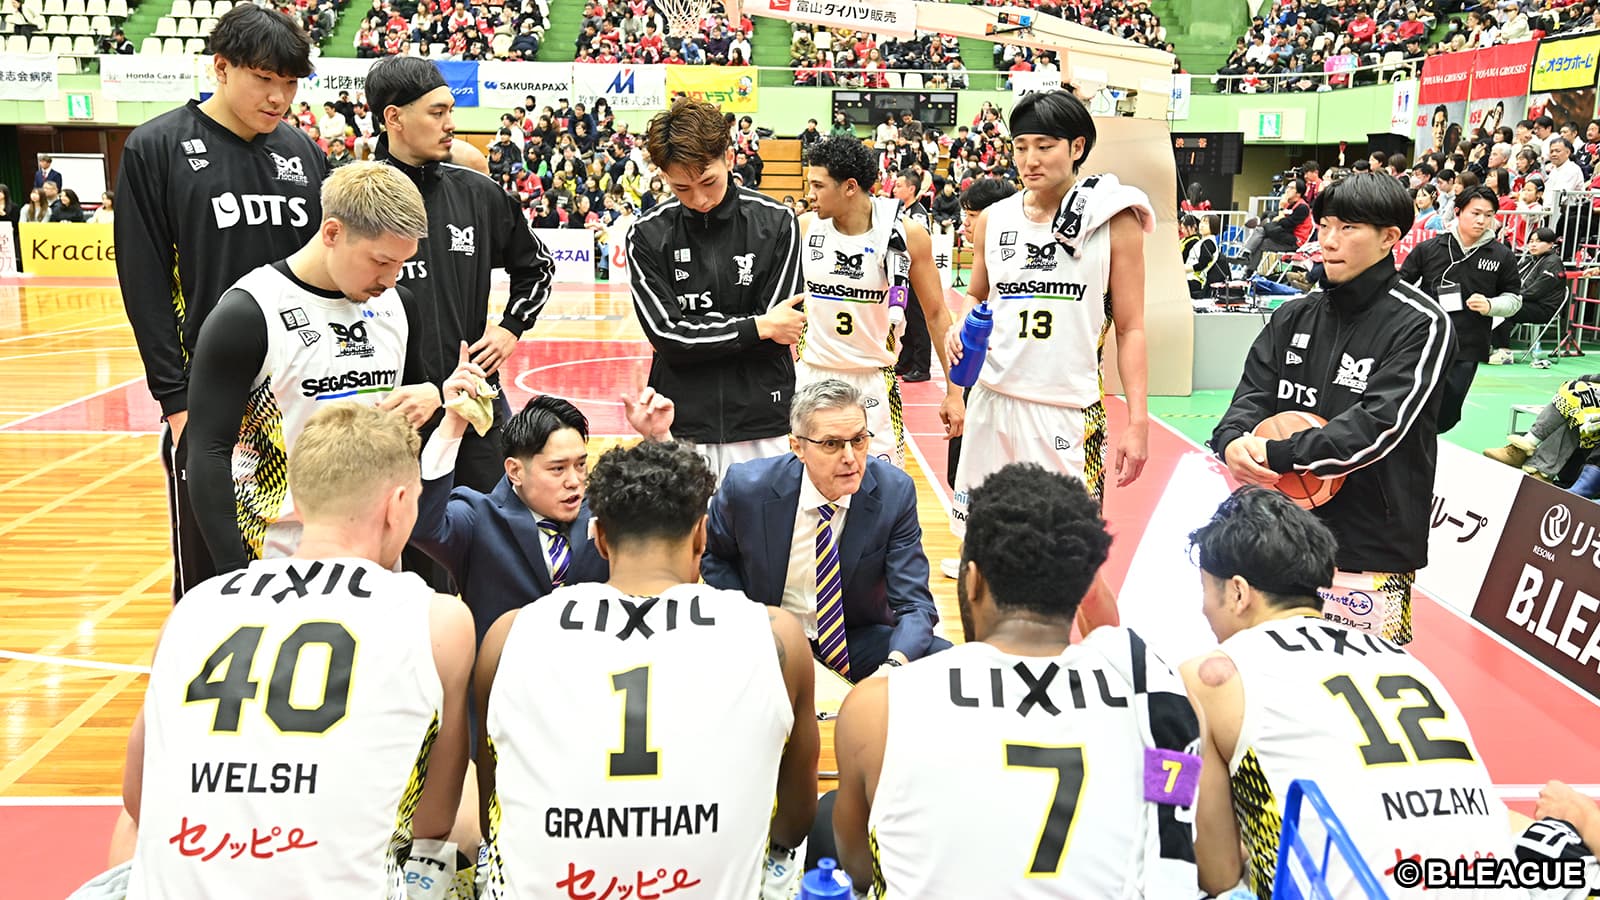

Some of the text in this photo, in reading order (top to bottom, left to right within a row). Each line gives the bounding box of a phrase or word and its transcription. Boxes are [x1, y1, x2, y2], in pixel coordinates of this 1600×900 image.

[500, 82, 568, 91] SAKURAPAXX
[241, 194, 309, 227] DTS
[32, 239, 116, 261] Kracie
[806, 281, 888, 304] SEGASammy
[897, 289, 906, 303] 3
[996, 280, 1087, 301] SEGASammy
[835, 311, 853, 336] 3
[1018, 310, 1053, 339] 13
[1277, 379, 1318, 407] DTS
[1532, 544, 1556, 562] RESONA
[220, 561, 372, 604] LIXIL
[559, 595, 716, 641] LIXIL
[1264, 625, 1407, 657] LIXIL
[183, 619, 359, 736] 40
[949, 661, 1128, 717] LIXIL
[607, 664, 661, 780] 1
[1322, 674, 1476, 766] 12
[191, 762, 318, 794] WELSH
[1162, 760, 1182, 793] 7
[1003, 740, 1087, 878] 7
[1381, 787, 1490, 820] NOZAKI
[545, 803, 719, 839] GRANTHAM
